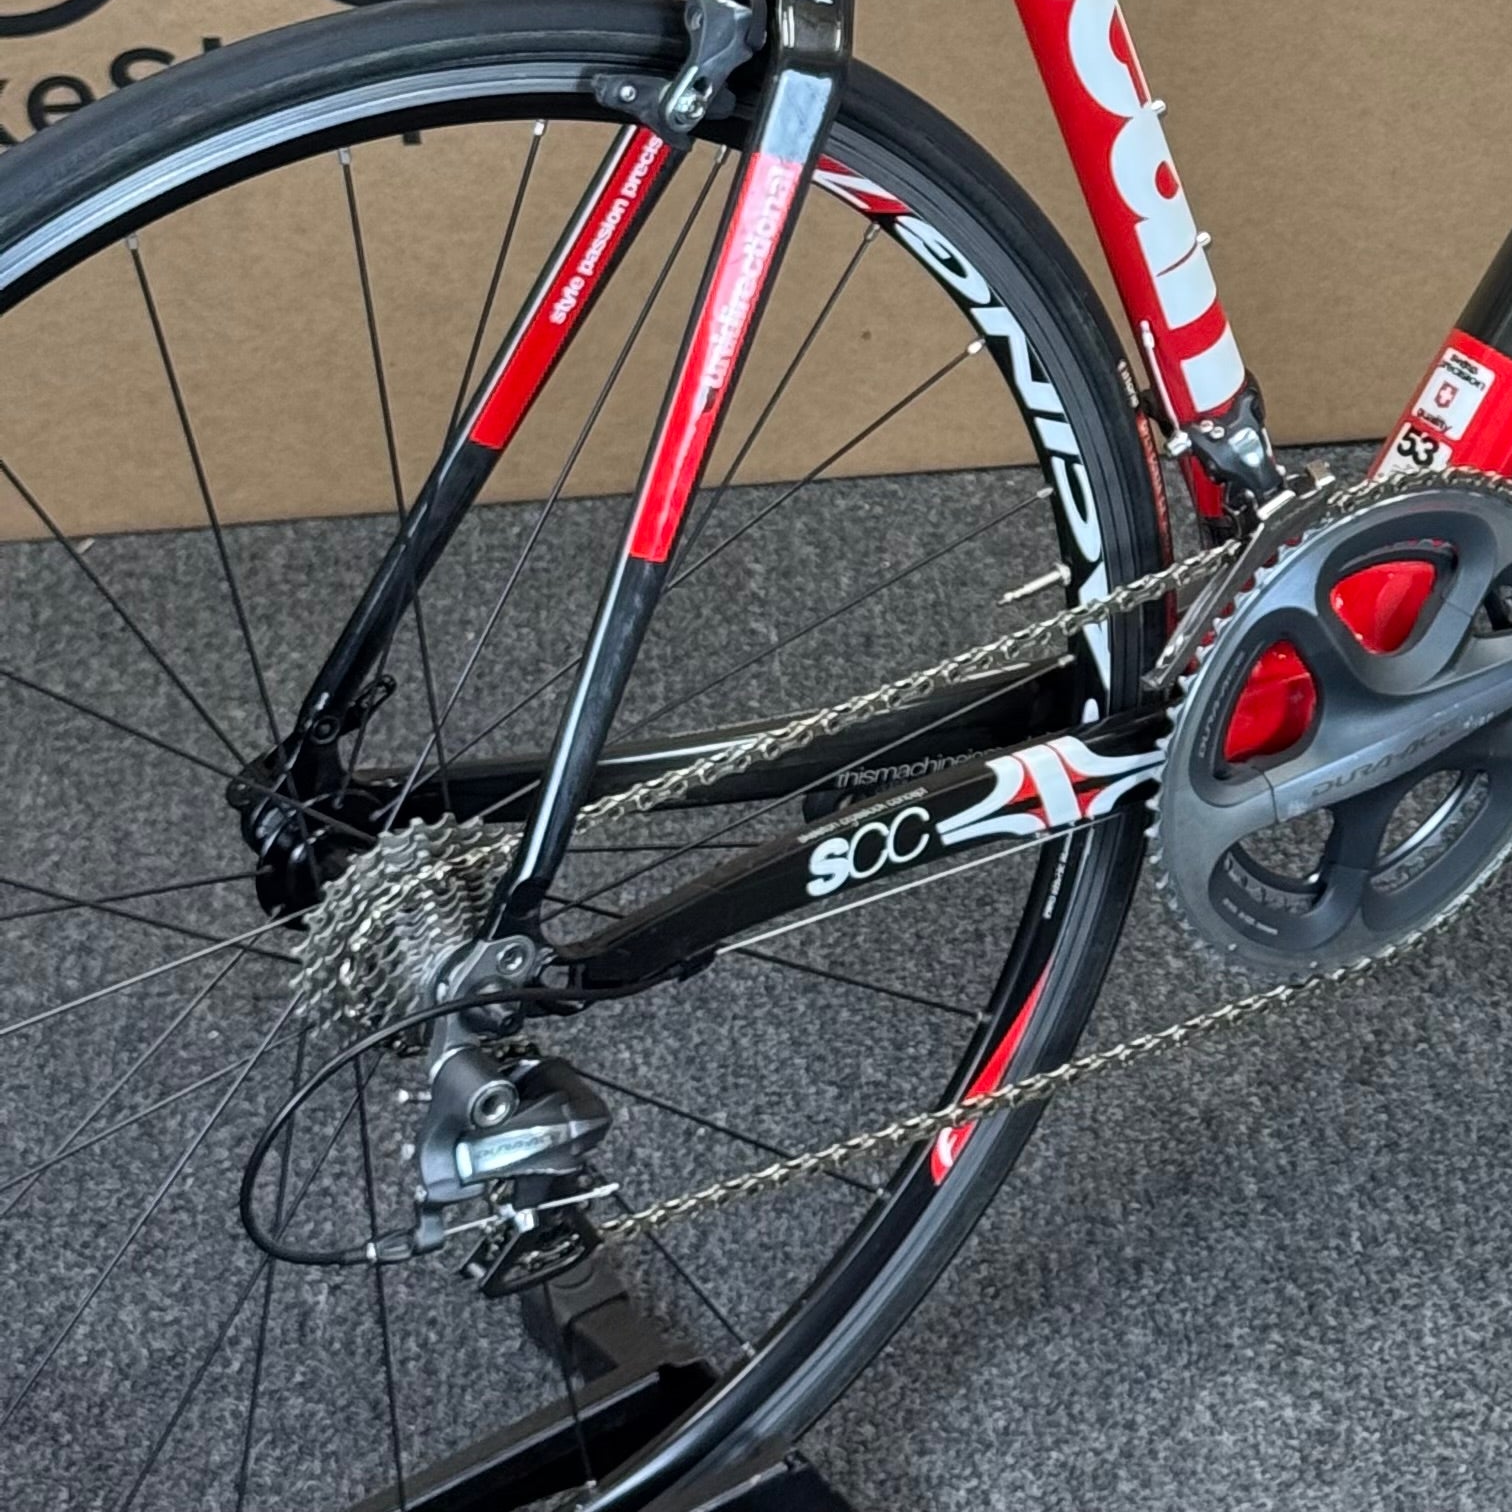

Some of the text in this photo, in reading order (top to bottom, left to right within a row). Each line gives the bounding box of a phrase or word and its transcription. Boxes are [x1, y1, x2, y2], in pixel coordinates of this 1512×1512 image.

[548, 283, 585, 326] style
[581, 195, 627, 280] passion
[706, 165, 797, 390] unidirectional
[1396, 426, 1440, 467] 53
